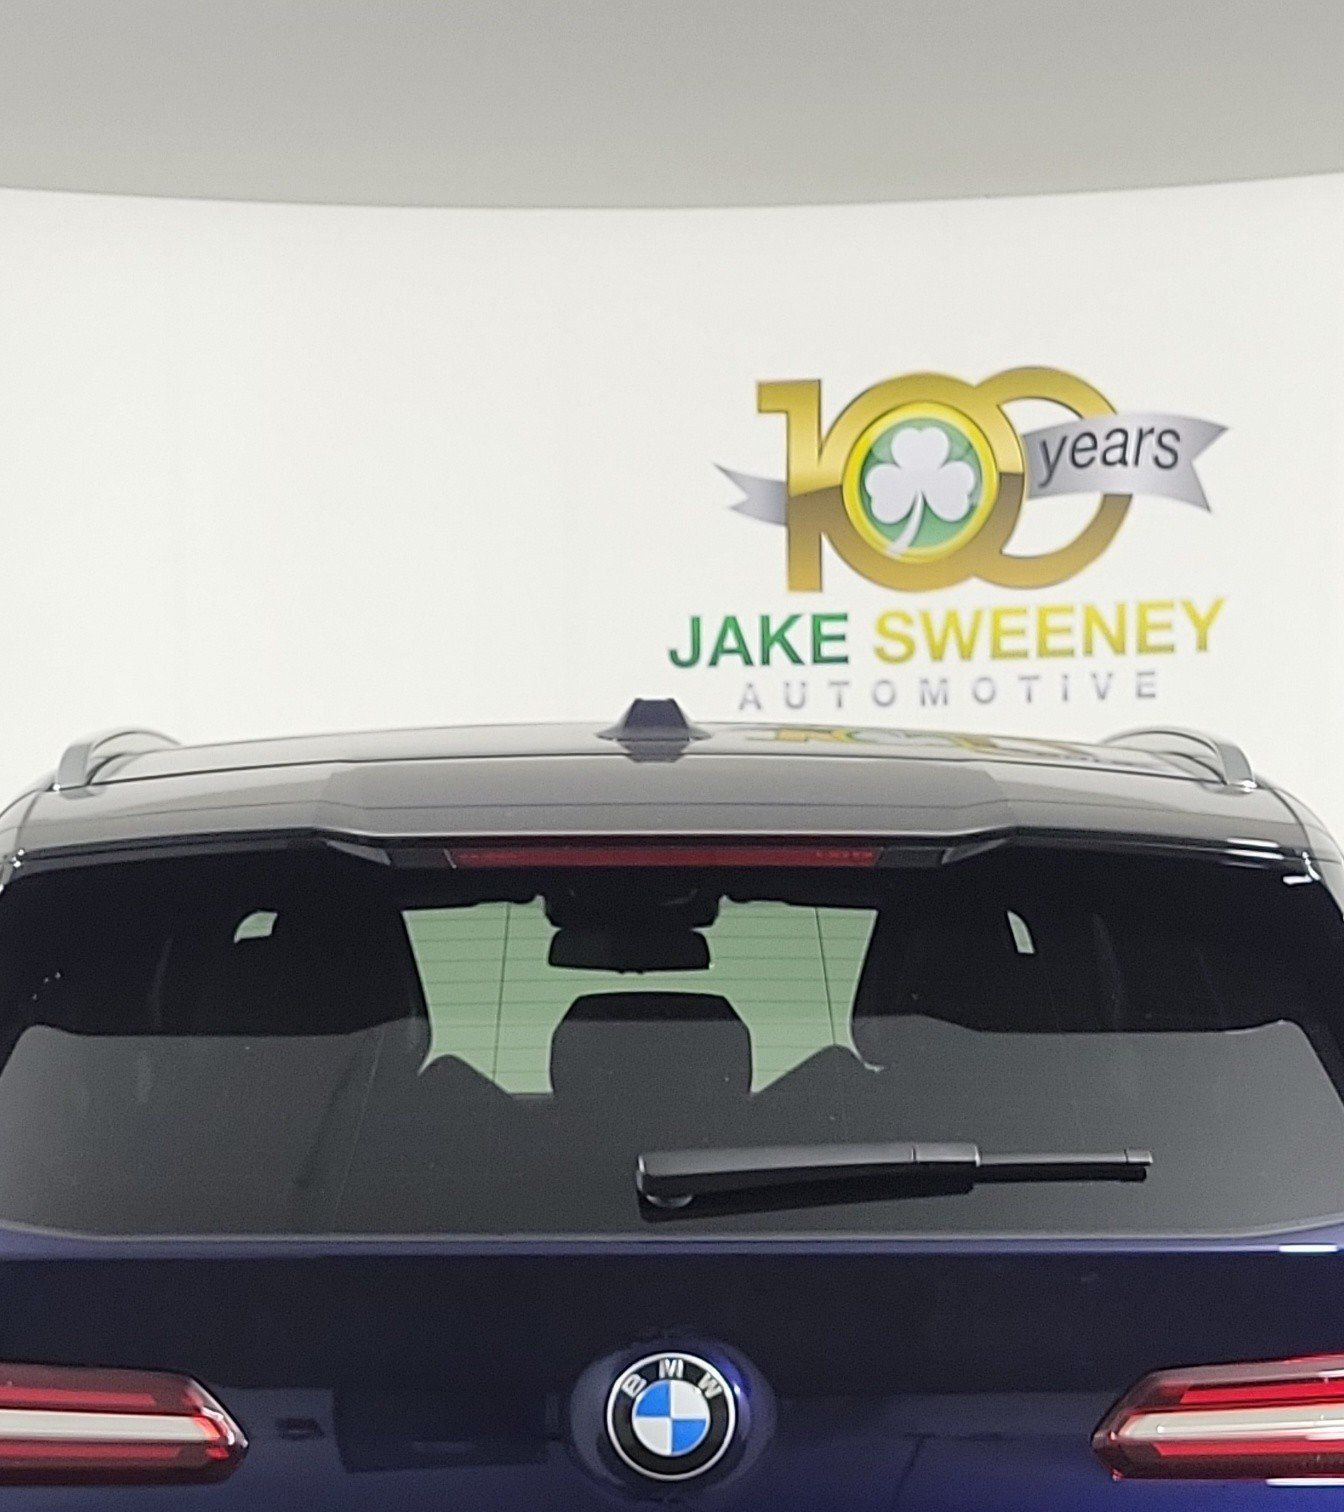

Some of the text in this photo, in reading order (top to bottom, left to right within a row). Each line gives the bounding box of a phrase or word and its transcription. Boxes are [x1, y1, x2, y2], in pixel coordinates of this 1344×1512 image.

[757, 366, 1133, 592] 100
[1037, 421, 1181, 489] years
[668, 598, 1227, 669] JAKE SWEENEY
[738, 671, 1158, 711] AUTOMOTIVE
[621, 1358, 723, 1399] BMW
